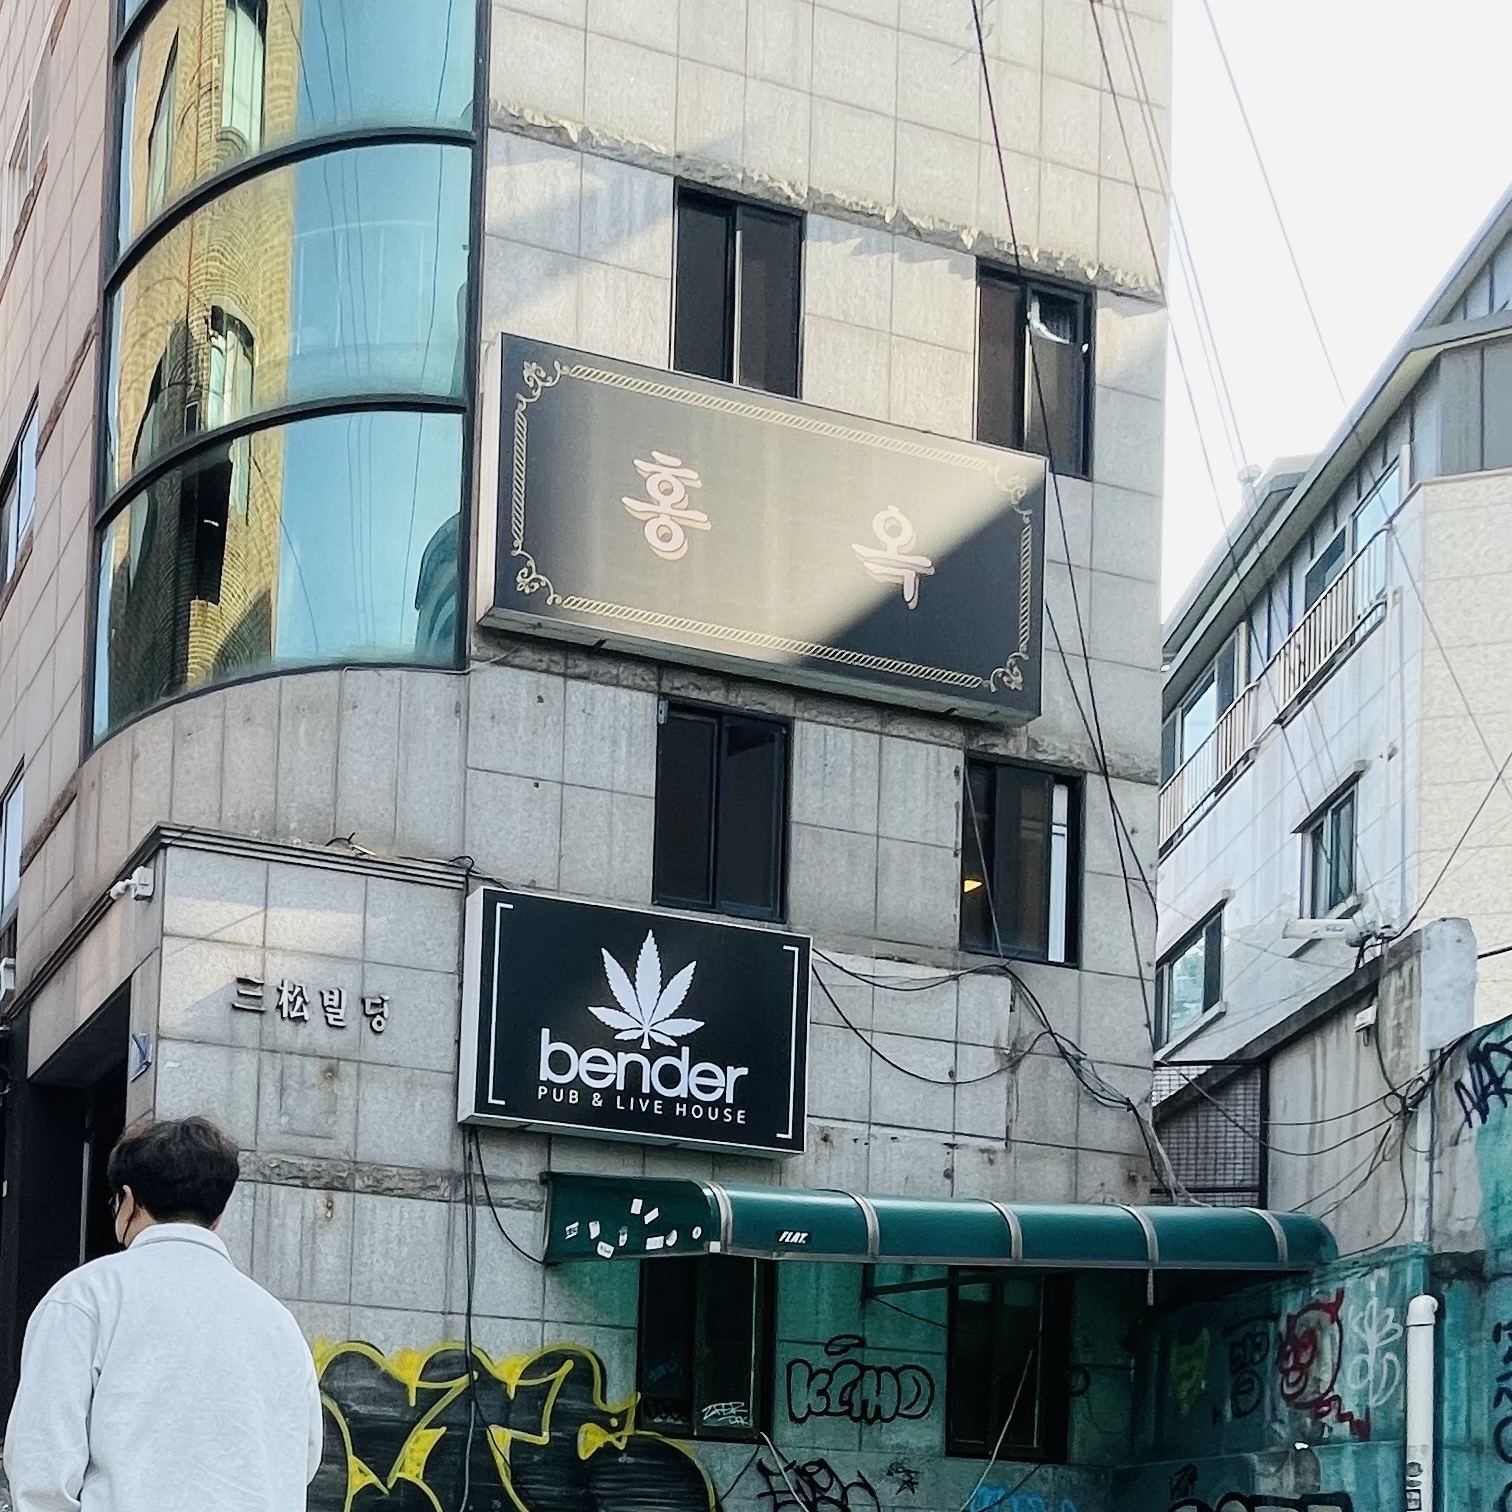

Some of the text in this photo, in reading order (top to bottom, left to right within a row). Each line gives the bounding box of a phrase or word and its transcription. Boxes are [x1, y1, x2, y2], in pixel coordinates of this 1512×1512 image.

[621, 450, 934, 609] 홍 옥
[539, 1027, 749, 1104] bender
[538, 1085, 746, 1124] PUB & LIVE HOUSE
